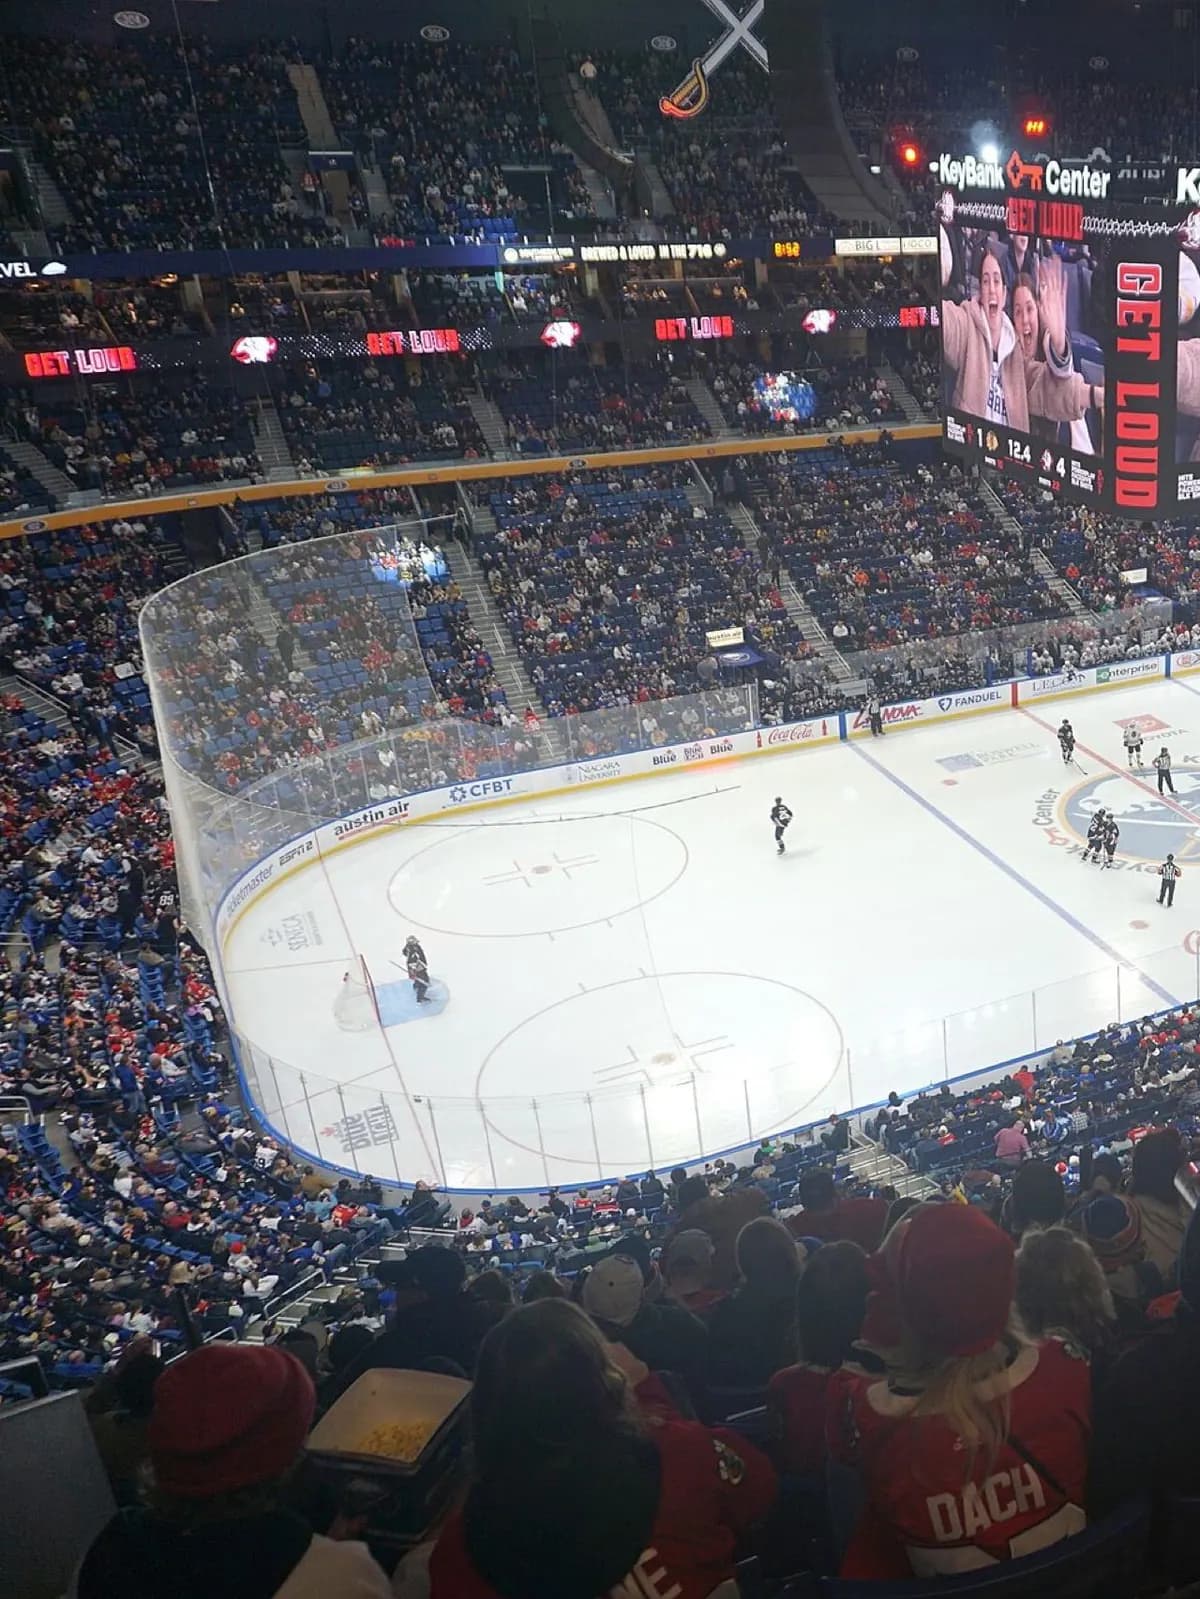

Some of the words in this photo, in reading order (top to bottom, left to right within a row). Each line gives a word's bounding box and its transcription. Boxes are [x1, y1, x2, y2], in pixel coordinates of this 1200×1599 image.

[940, 153, 1005, 191] KeyBank
[1046, 161, 1110, 198] Center
[1116, 262, 1162, 360] GET
[691, 316, 733, 338] LOUD
[409, 329, 459, 353] LOUD
[75, 346, 136, 373] LOUD
[977, 428, 982, 448] 1
[1008, 439, 1031, 463] 12.4
[1056, 457, 1065, 478] 4
[1116, 380, 1159, 508] LOUD
[1100, 661, 1157, 682] enterprise
[955, 691, 1001, 707] FANDUEL
[881, 705, 918, 721] NOVA
[768, 723, 814, 744] Coca-Cola
[653, 753, 677, 766] Blue
[711, 742, 733, 755] Blue
[578, 761, 620, 774] NIAGARA
[579, 770, 621, 783] UNIVERSITY
[470, 779, 512, 797] CFBT
[334, 810, 384, 836] austin
[389, 801, 410, 815] air
[1032, 788, 1060, 826] Center
[341, 1113, 371, 1152] Blue
[926, 1462, 1046, 1541] DACH
